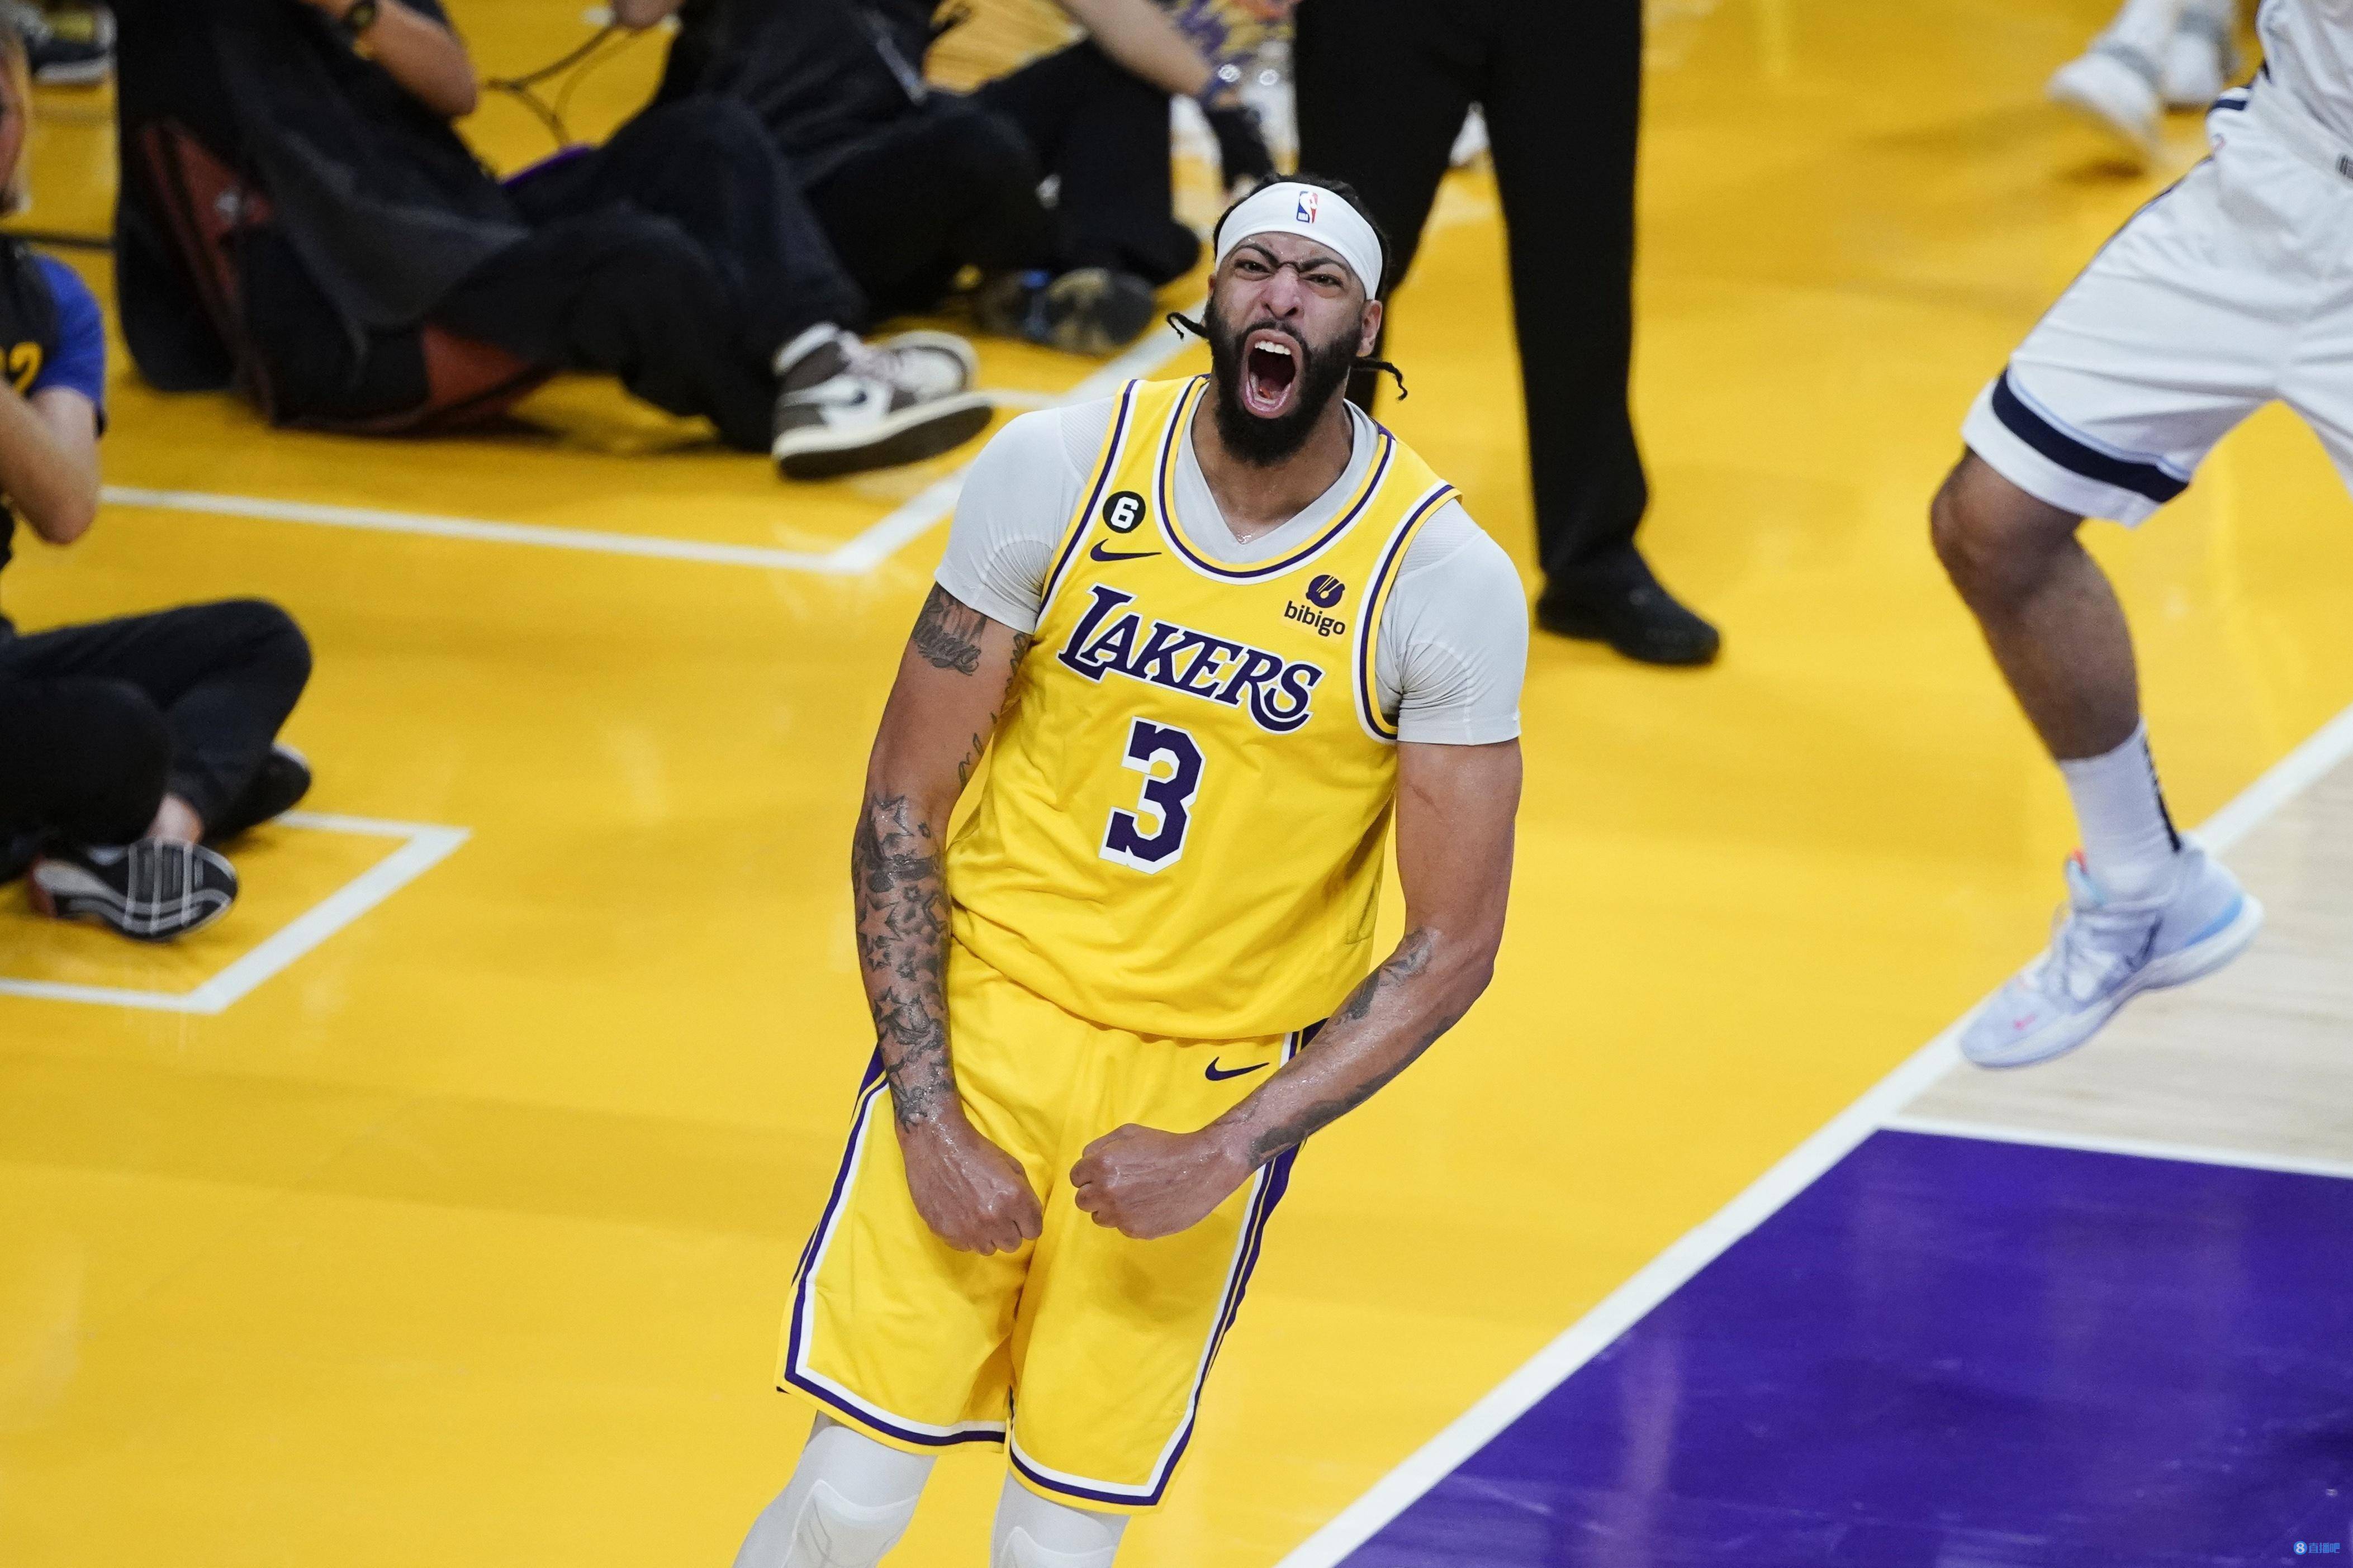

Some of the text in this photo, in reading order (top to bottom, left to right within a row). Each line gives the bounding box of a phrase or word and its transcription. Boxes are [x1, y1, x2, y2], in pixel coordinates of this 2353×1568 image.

[1109, 495, 1139, 530] 6
[1057, 582, 1326, 735] LAKERS
[1284, 601, 1346, 638] bibigo
[1099, 716, 1207, 875] 3
